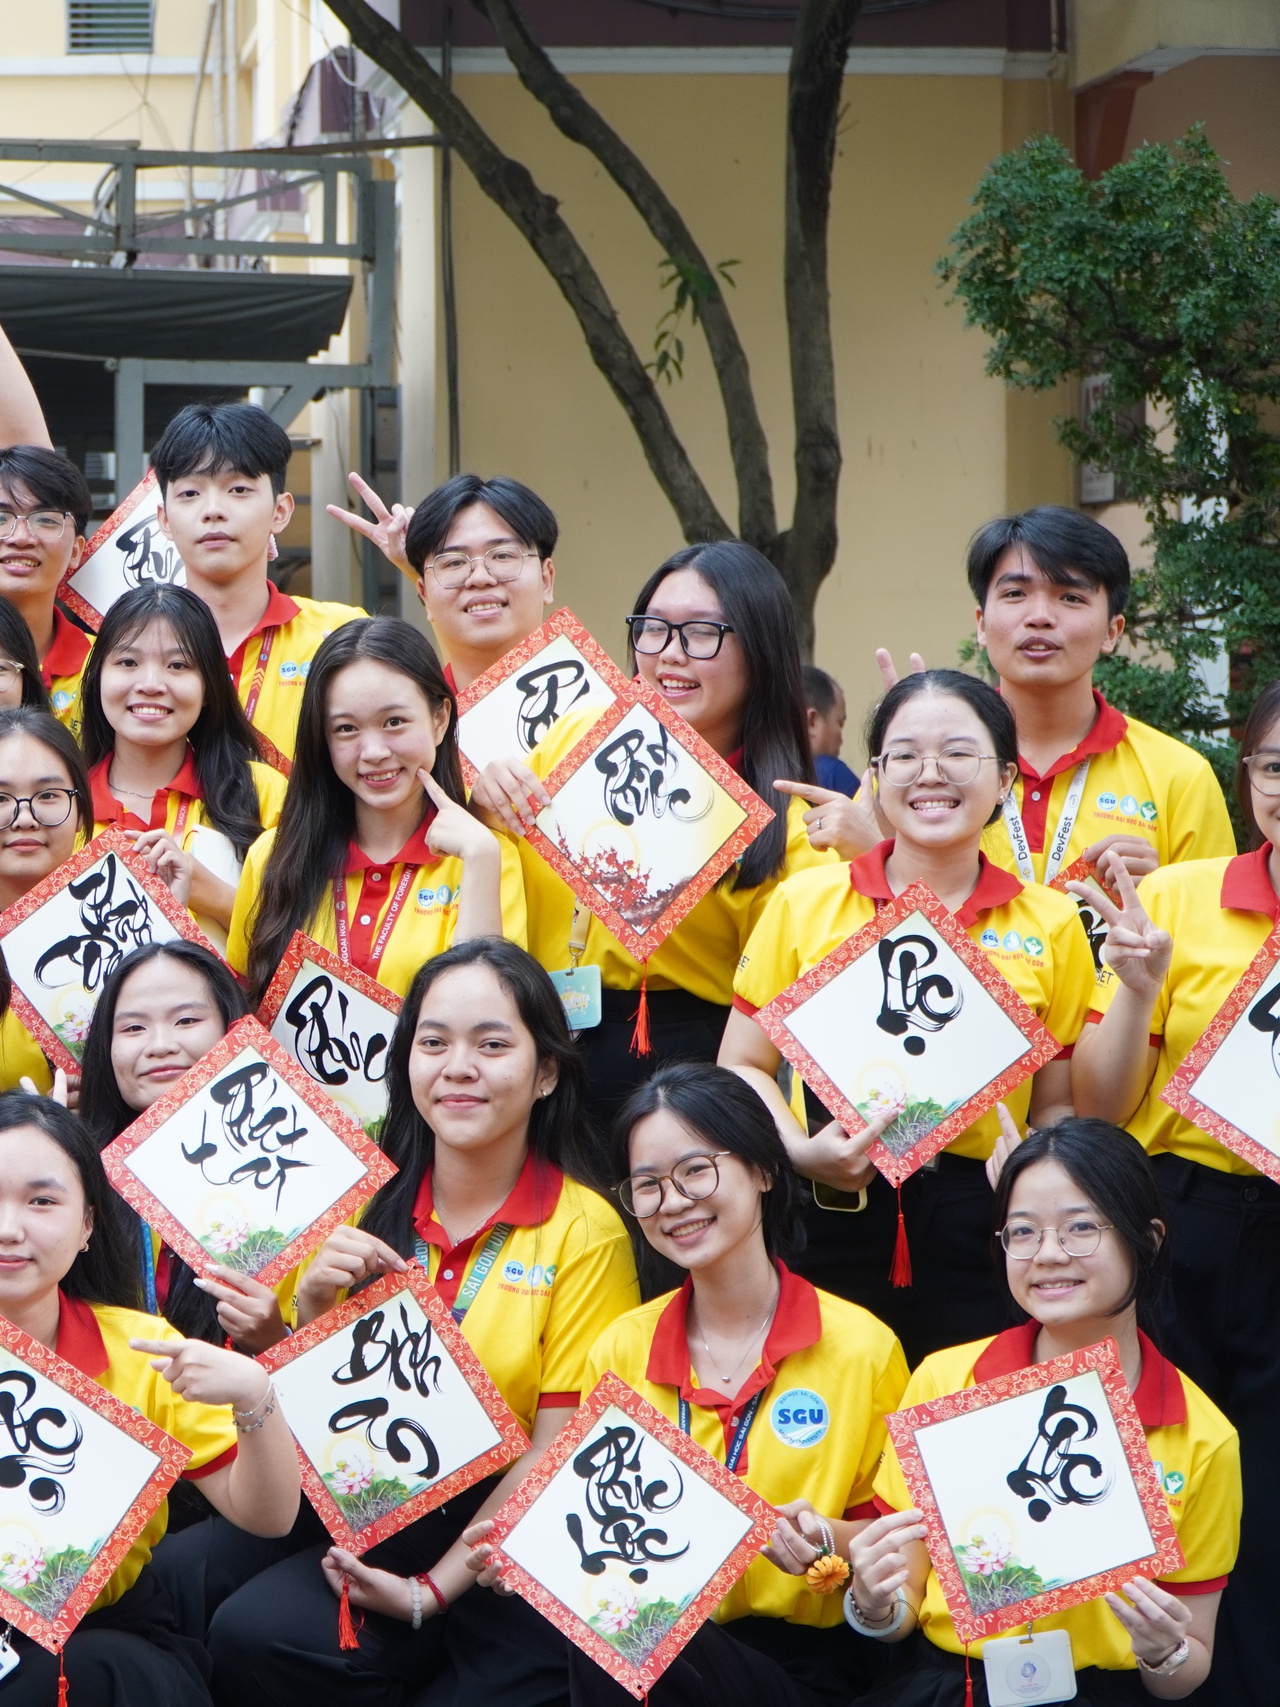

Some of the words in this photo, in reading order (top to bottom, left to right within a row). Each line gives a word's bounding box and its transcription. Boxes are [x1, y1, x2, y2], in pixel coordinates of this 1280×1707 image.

[1099, 797, 1116, 805] SGU
[1009, 815, 1028, 861] DevFest
[1052, 816, 1073, 861] DevFest
[372, 946, 382, 960] THE
[380, 913, 396, 946] FACULTY
[391, 902, 400, 912] OF
[396, 869, 412, 901] FOREIGN
[462, 1280, 482, 1298] SAI
[475, 1247, 496, 1275] GON
[490, 1224, 511, 1247] UNI
[505, 1266, 523, 1276] SGU
[778, 1409, 823, 1425] SGU
